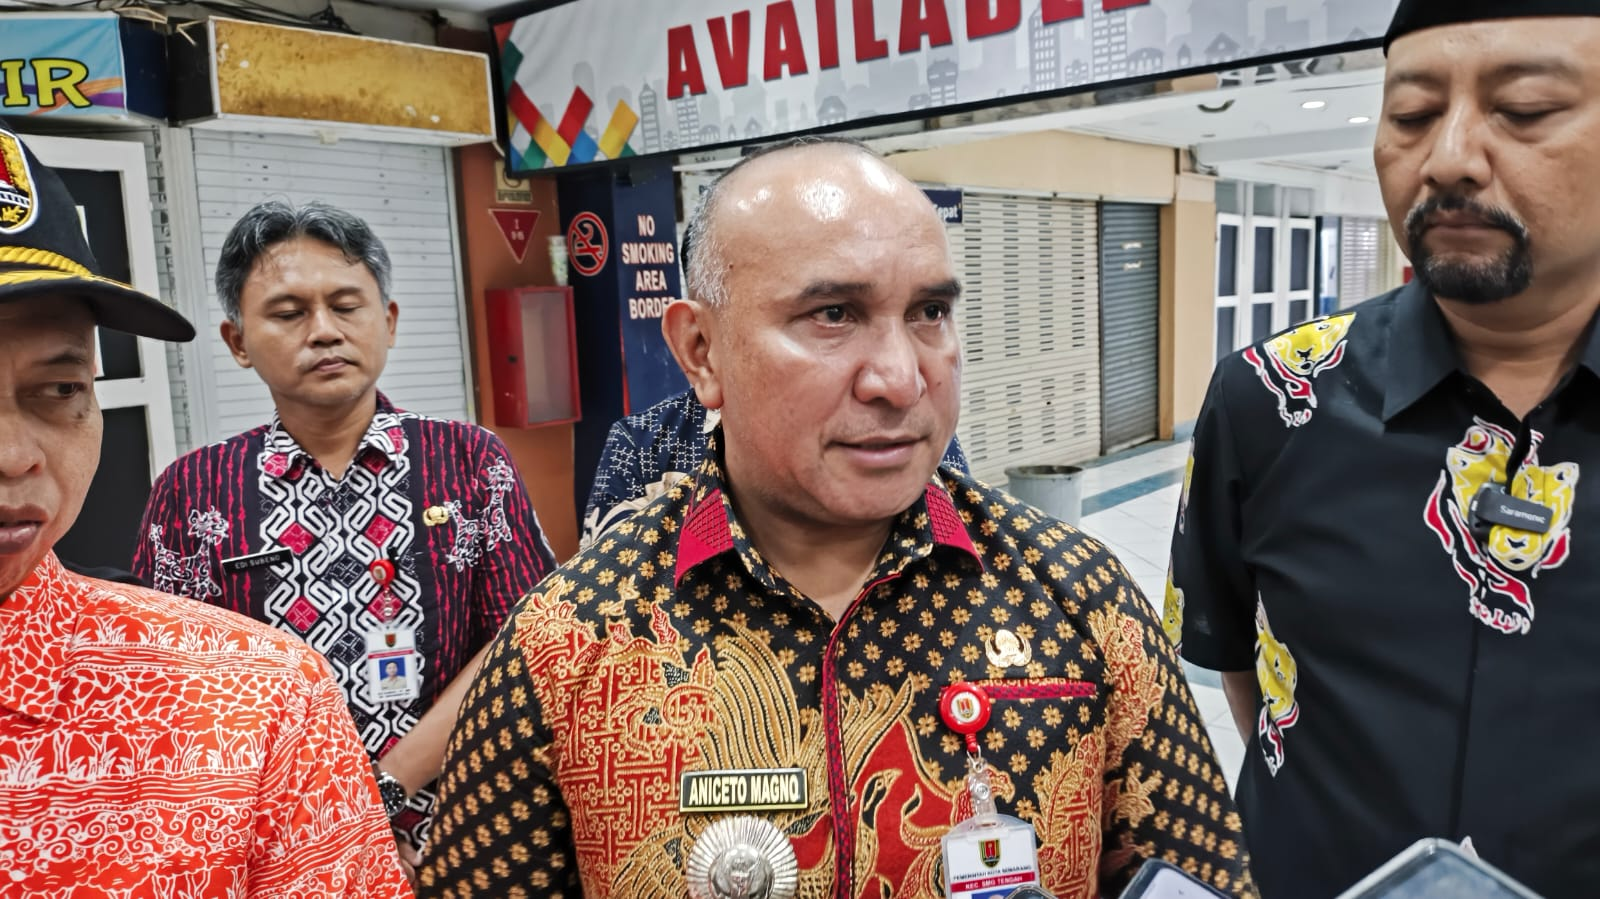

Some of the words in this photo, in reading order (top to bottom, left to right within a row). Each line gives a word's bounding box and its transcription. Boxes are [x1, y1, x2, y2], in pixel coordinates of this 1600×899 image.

[667, 0, 1152, 100] AVAILA
[637, 214, 656, 237] NO
[621, 242, 675, 265] SMOKING
[635, 269, 668, 291] AREA
[628, 296, 676, 320] BORDE
[688, 776, 748, 806] ANICETO
[750, 774, 800, 804] MAGNO
[981, 879, 996, 887] SMG
[997, 876, 1023, 886] TENGAH
